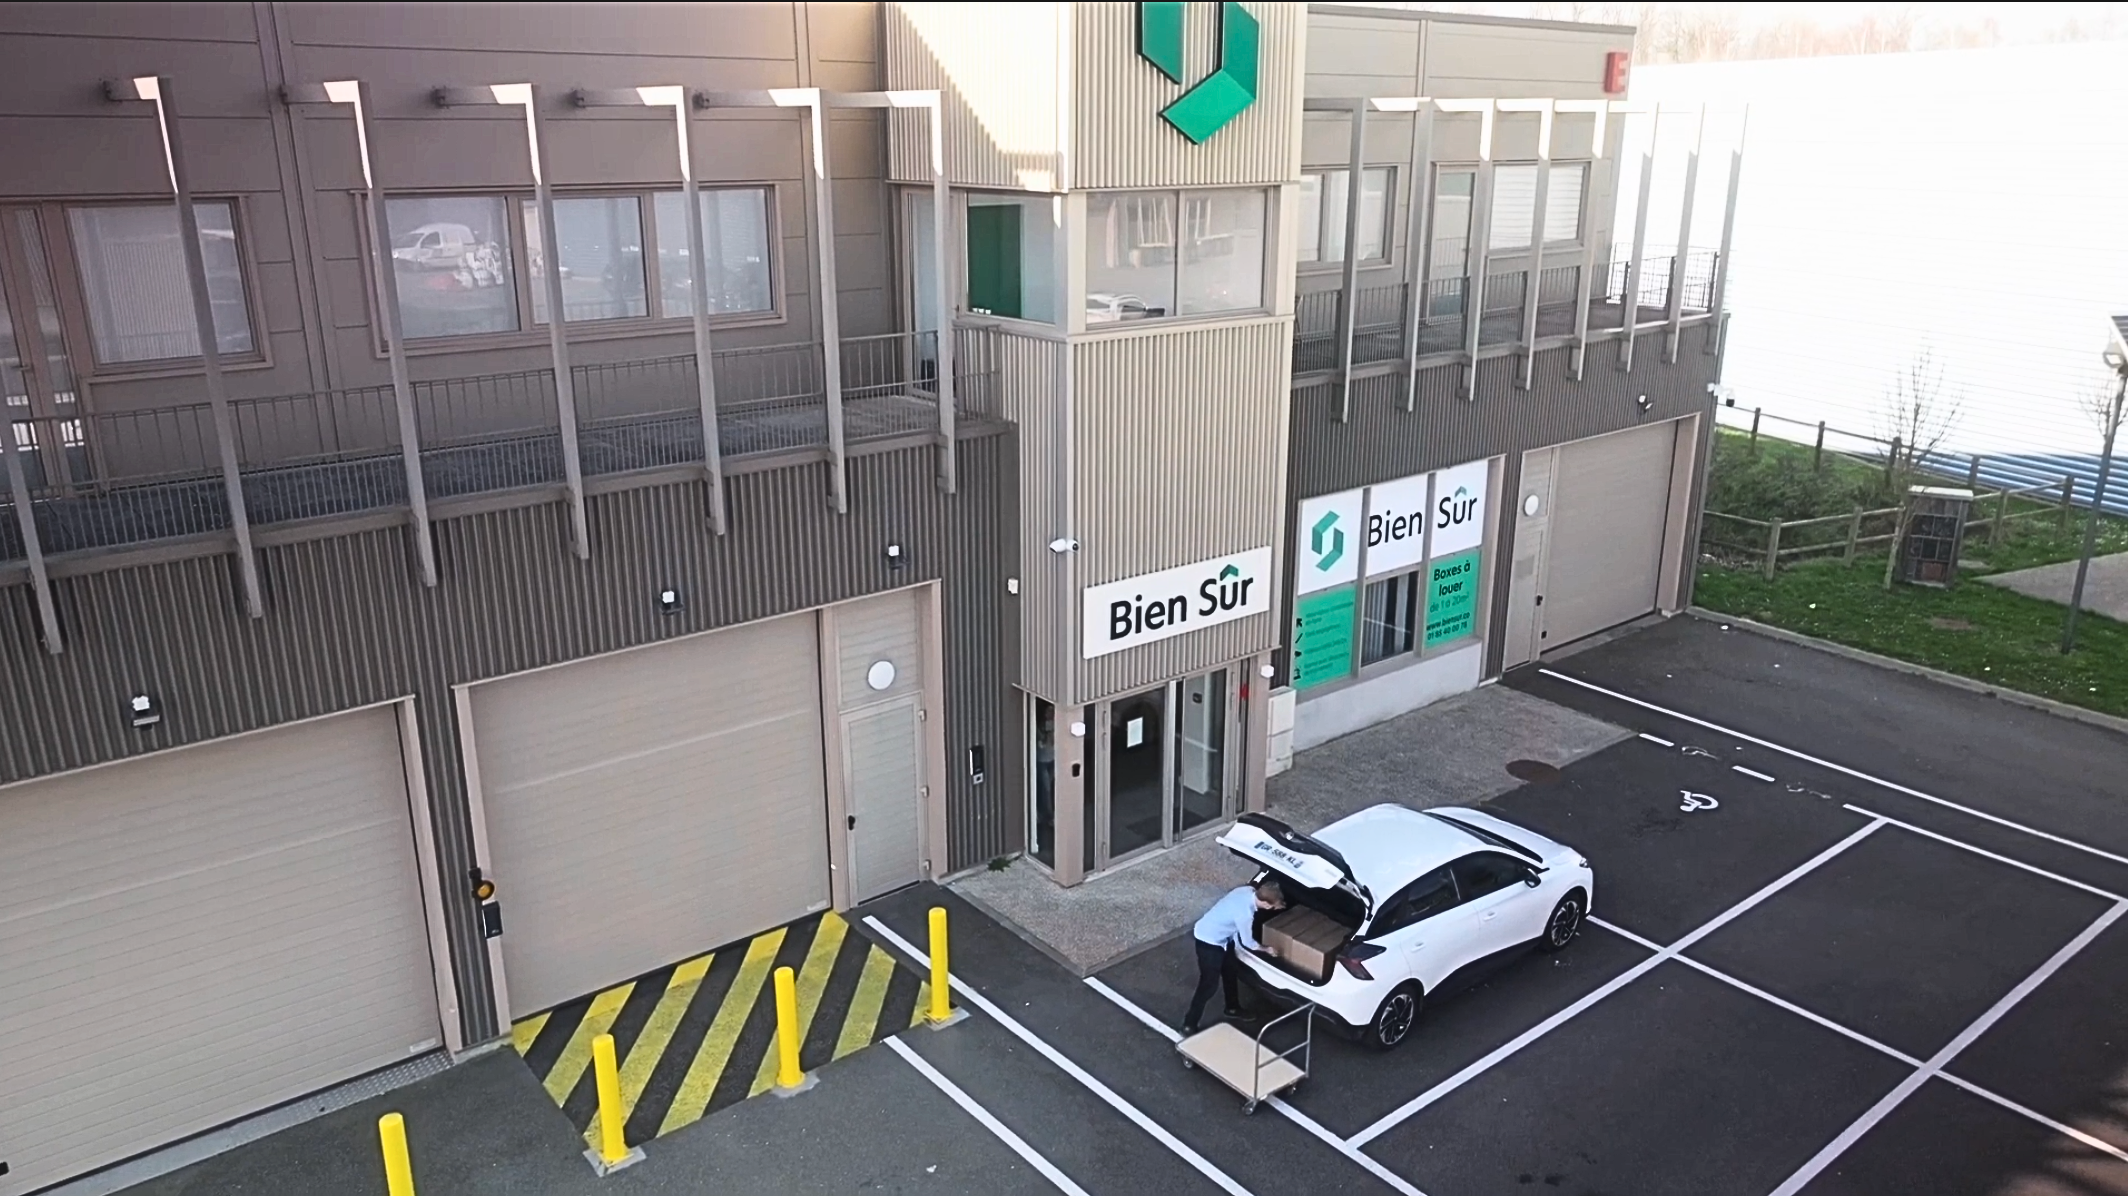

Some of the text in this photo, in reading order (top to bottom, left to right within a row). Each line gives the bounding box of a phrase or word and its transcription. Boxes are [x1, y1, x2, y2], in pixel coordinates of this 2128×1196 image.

[1604, 52, 1628, 93] E
[1367, 485, 1478, 548] Bien Sûr
[1433, 560, 1471, 581] Boxes à
[1110, 564, 1254, 641] Bien Sûr
[1438, 581, 1463, 597] louer
[1429, 602, 1440, 613] de
